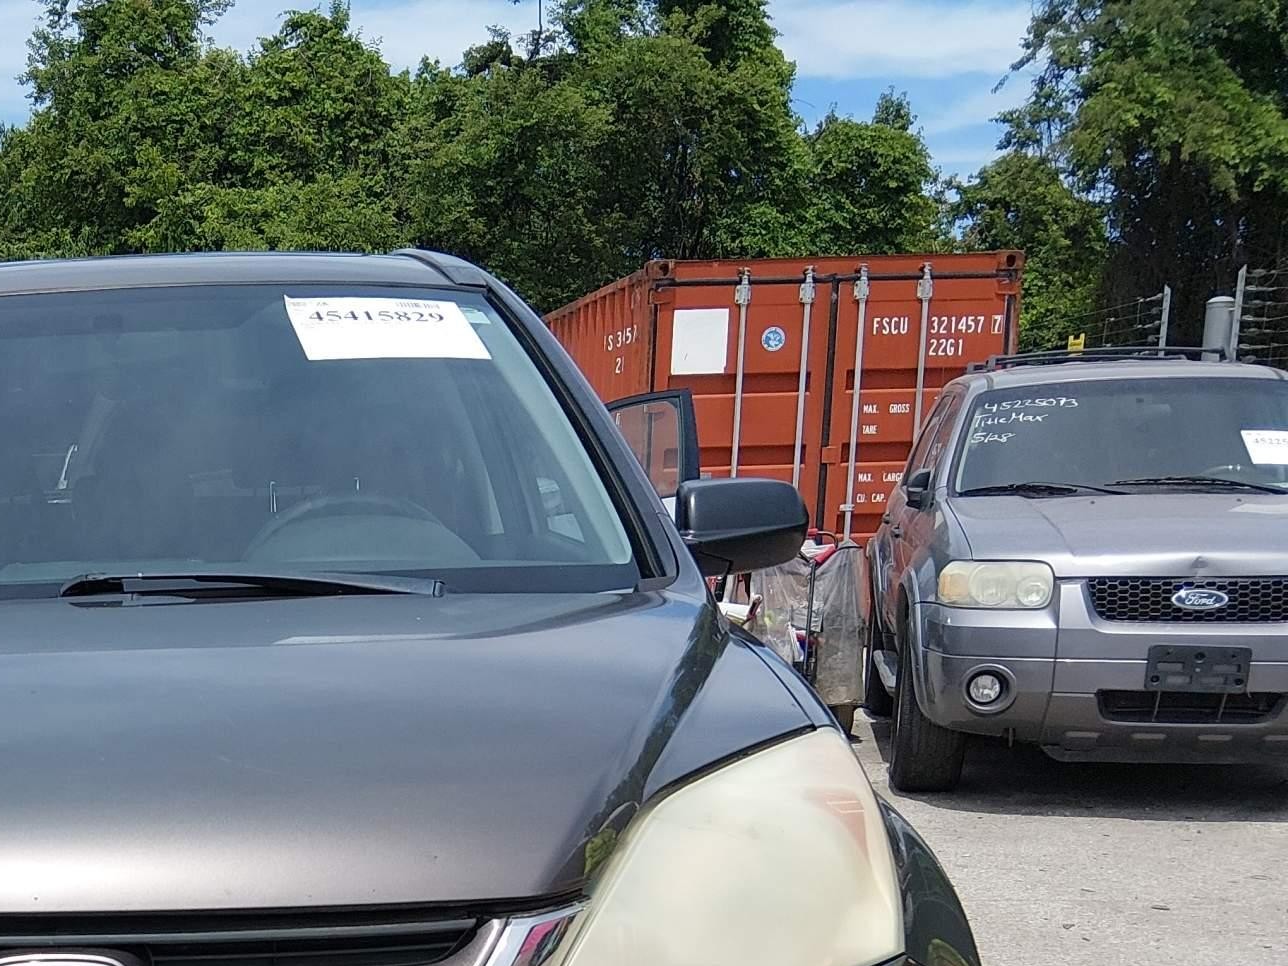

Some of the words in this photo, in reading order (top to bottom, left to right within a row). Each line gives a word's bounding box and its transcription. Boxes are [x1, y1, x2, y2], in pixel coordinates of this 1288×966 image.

[309, 310, 444, 322] 45415829
[872, 316, 909, 335] FSCU
[930, 315, 985, 334] 321457
[928, 338, 963, 356] 22G1
[863, 404, 880, 414] MAX.
[889, 403, 911, 414] GROSS
[862, 425, 878, 435] TARE
[858, 472, 874, 482] MAX.
[871, 493, 887, 503] CAP.
[1184, 592, 1217, 606] Ford
